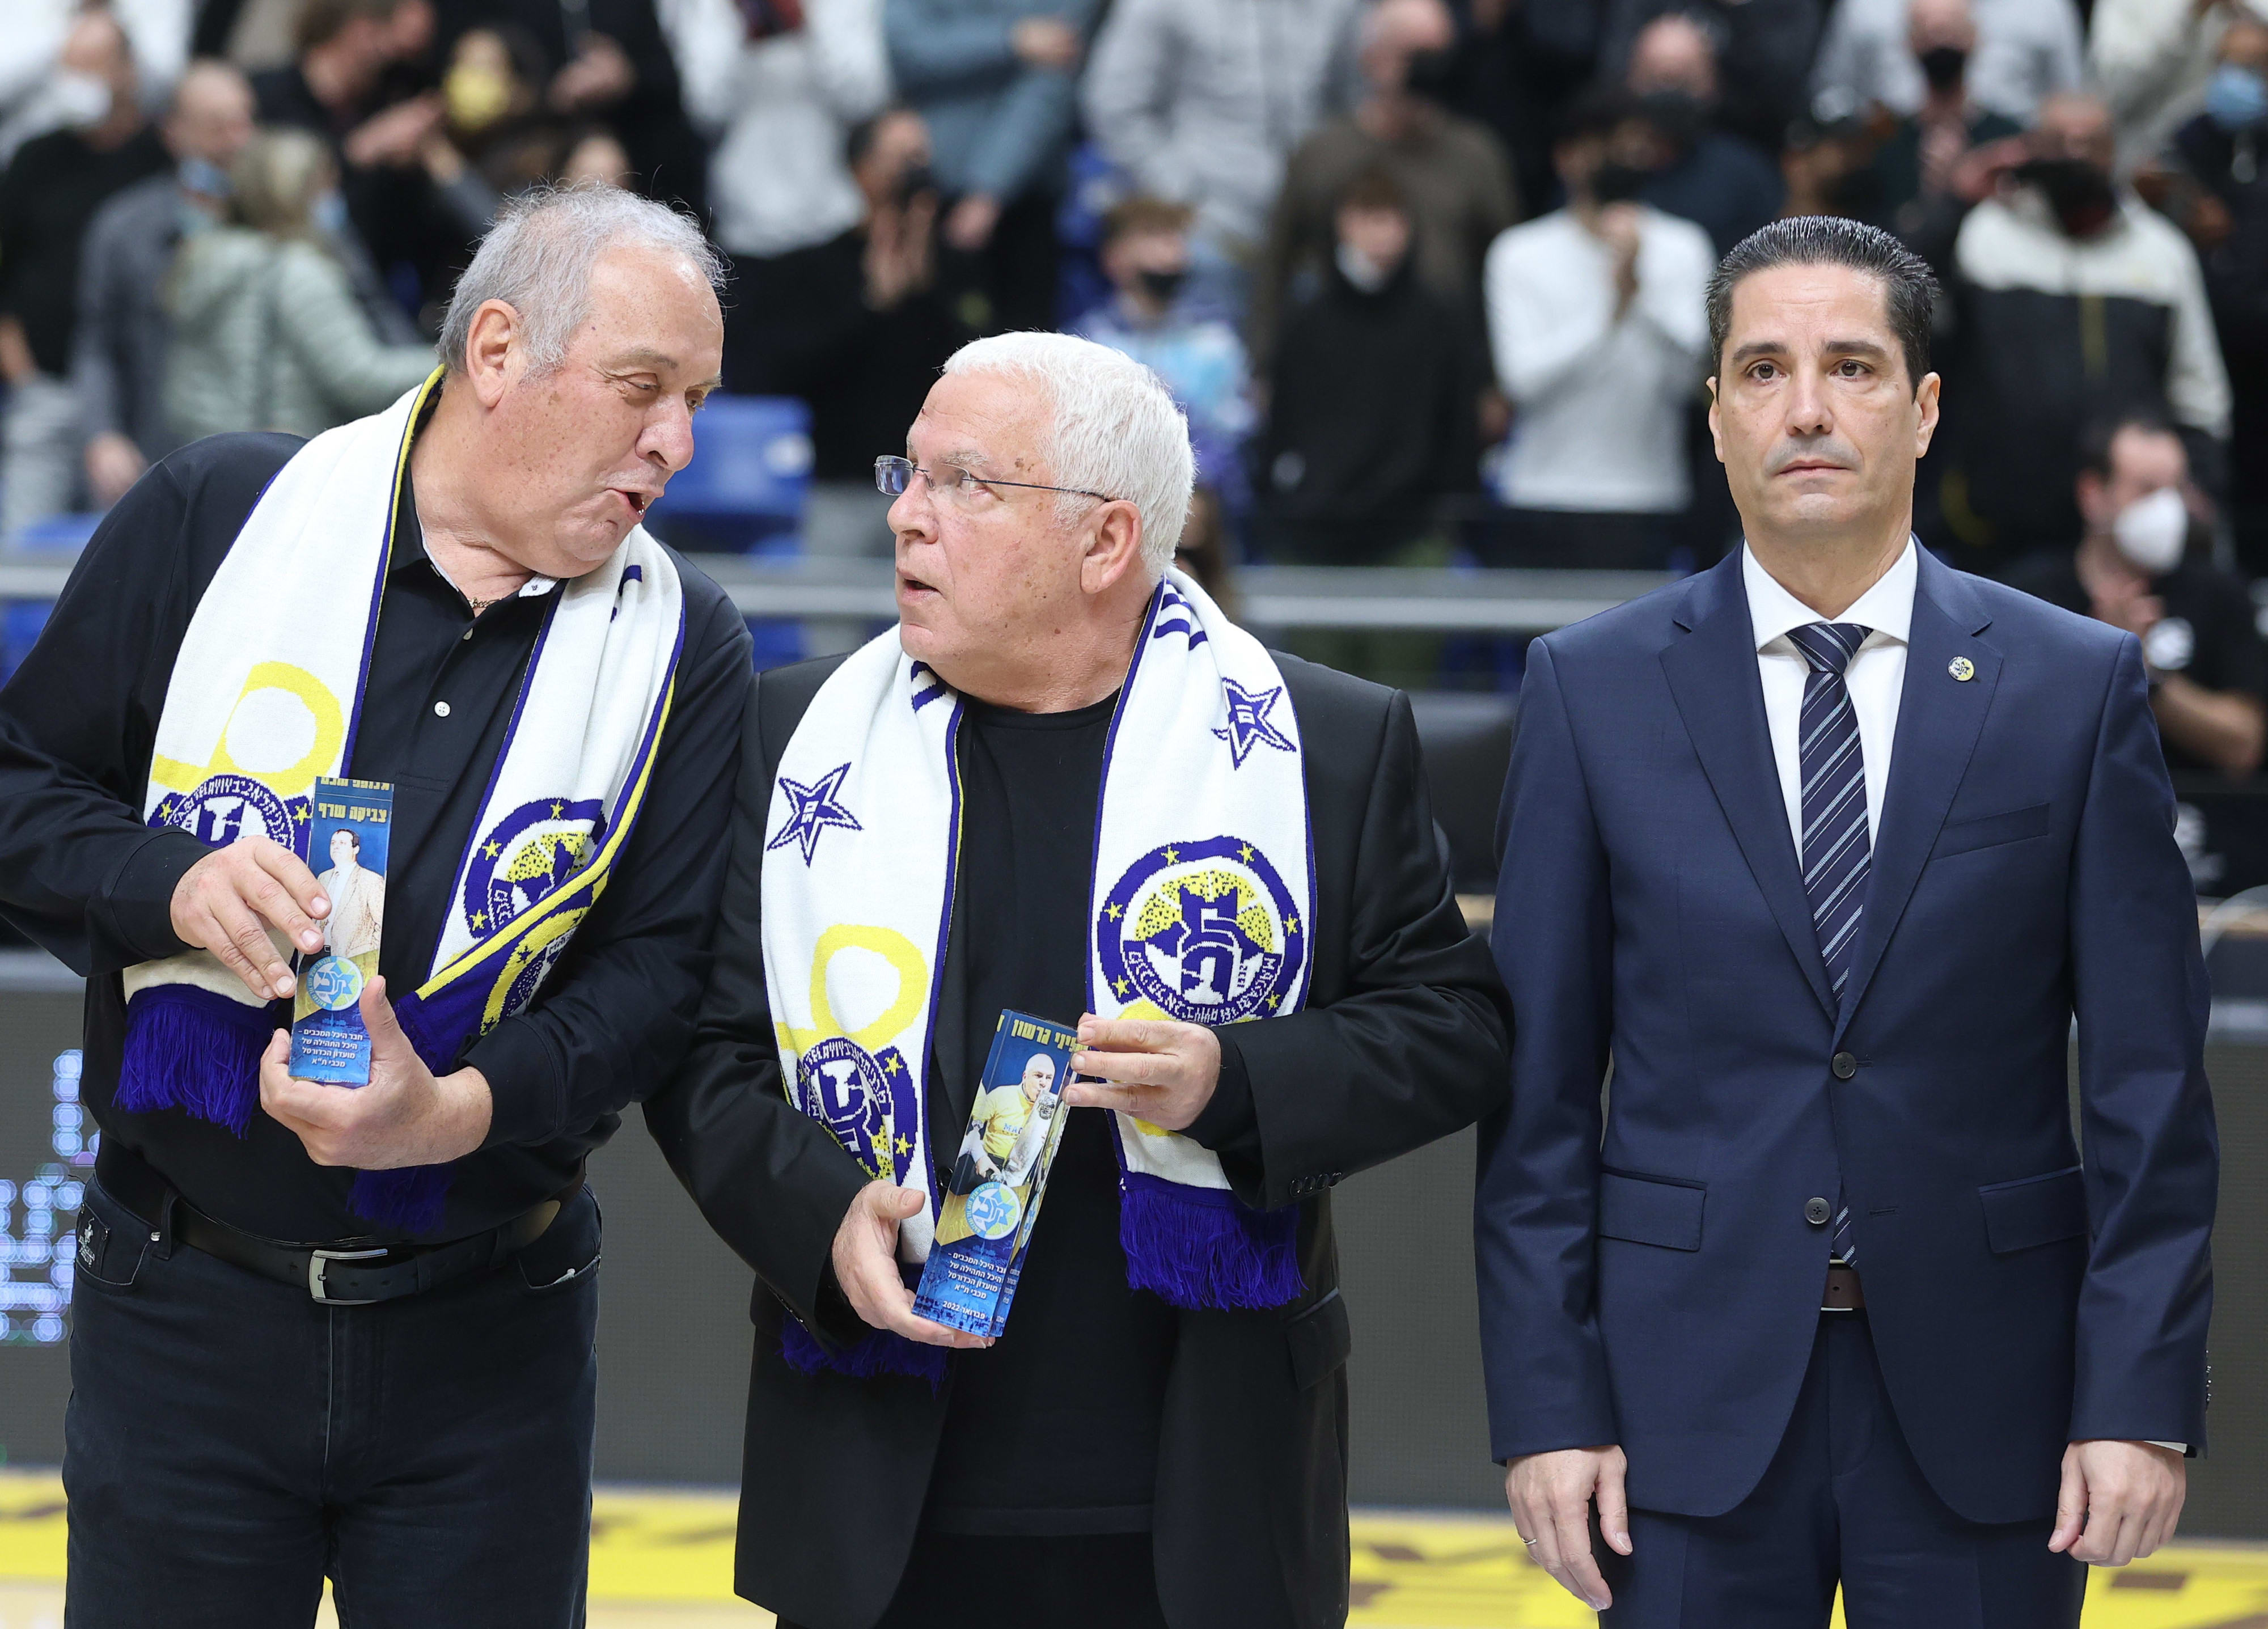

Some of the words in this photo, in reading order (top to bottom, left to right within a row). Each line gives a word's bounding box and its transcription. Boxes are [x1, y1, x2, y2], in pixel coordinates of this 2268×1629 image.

[318, 802, 347, 819] שרף
[349, 806, 387, 823] צביקה
[331, 1030, 348, 1039] היכל
[1011, 1019, 1051, 1045] גרשון
[313, 1039, 340, 1048] התהילה
[341, 1041, 358, 1050] היכל
[302, 1047, 332, 1056] הכדורסל
[949, 1260, 959, 1269] של
[953, 1253, 978, 1265] המכבים
[980, 1259, 995, 1270] היכל
[960, 1265, 985, 1278] התהילה
[948, 1270, 975, 1285] הכדורסל
[976, 1281, 998, 1292] מועדון
[971, 1288, 987, 1300] מכבי
[942, 1301, 960, 1311] 2022
[962, 1306, 986, 1319] פברואר
